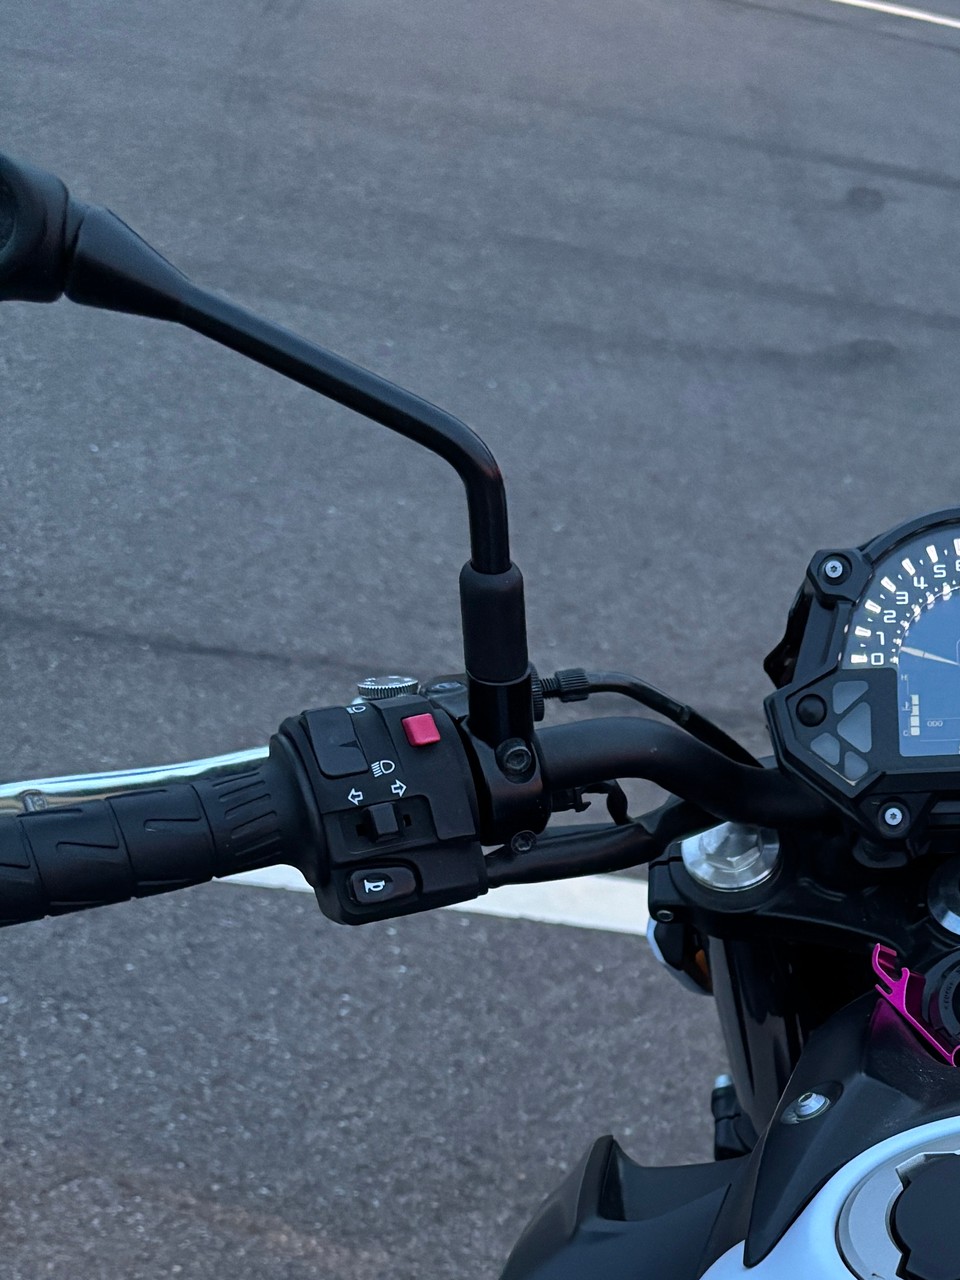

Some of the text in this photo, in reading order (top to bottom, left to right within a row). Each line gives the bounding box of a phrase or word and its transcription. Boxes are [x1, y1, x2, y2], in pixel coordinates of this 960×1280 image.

[933, 564, 947, 578] 5
[913, 576, 928, 589] 4
[895, 591, 909, 605] 3
[883, 610, 897, 624] 2
[876, 632, 885, 646] 1
[870, 653, 884, 665] 0
